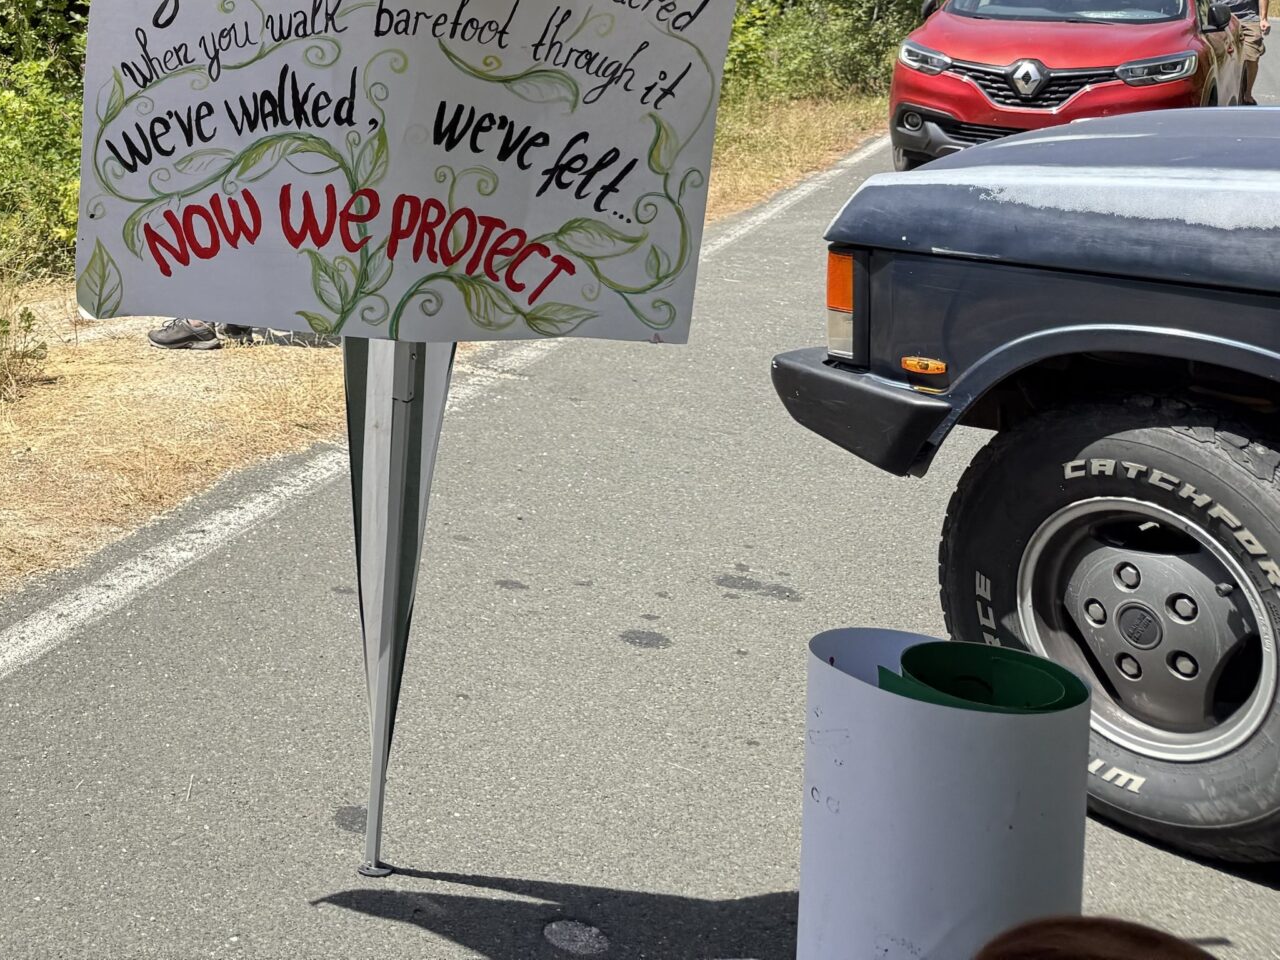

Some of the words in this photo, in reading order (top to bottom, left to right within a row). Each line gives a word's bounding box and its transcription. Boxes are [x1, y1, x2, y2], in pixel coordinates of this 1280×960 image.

[120, 27, 195, 89] when
[199, 20, 258, 82] you
[531, 5, 649, 104] through
[640, 61, 693, 111] it
[144, 187, 262, 278] NOW
[1062, 458, 1280, 598] CATCHFOR
